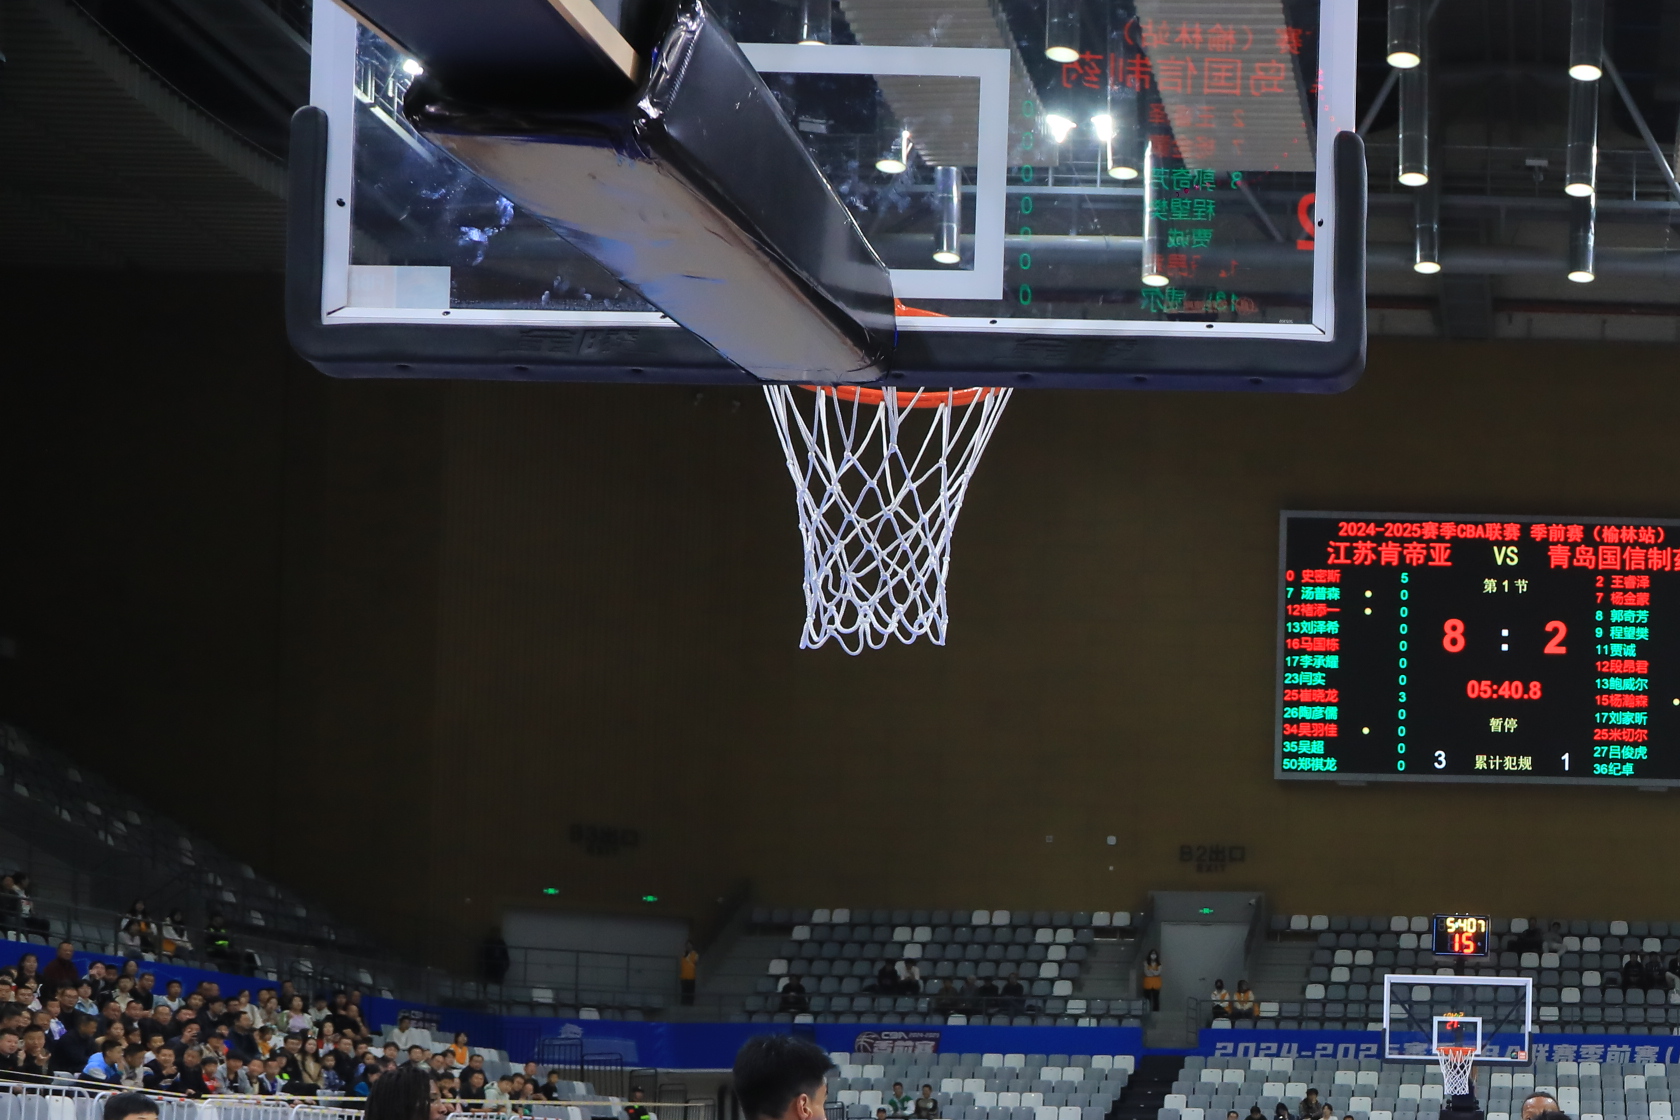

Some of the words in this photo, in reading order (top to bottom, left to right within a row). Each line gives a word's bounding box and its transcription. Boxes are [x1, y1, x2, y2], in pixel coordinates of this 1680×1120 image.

[1338, 522, 1521, 541] 2024-2025赛季CBA联赛
[1327, 540, 1452, 566] 江苏肯帝亚
[1493, 546, 1518, 565] VS
[1285, 570, 1295, 581] 0
[1301, 569, 1341, 583] 史密斯
[1401, 573, 1408, 583] 5
[1596, 576, 1604, 587] 2
[1483, 578, 1497, 593] 第
[1503, 580, 1508, 592] 1
[1515, 579, 1528, 593] 节
[1286, 588, 1294, 598] 7
[1301, 586, 1340, 600] 汤普森
[1400, 590, 1408, 600] 0
[1596, 592, 1604, 603] 7
[1400, 607, 1408, 617] 0
[1595, 610, 1603, 621] 8
[1400, 624, 1407, 634] 0
[1595, 627, 1603, 638] 9
[1442, 619, 1466, 653] 8
[1544, 620, 1567, 654] 2
[1286, 637, 1340, 651] 16马国栋
[1399, 641, 1407, 651] 0
[1596, 643, 1636, 657] 11贾诚
[1399, 658, 1407, 668] 0
[1399, 675, 1406, 685] 0
[1399, 692, 1406, 702] 3
[1467, 680, 1542, 700] 05:40.8
[1398, 709, 1406, 719] 0
[1398, 726, 1406, 736] 0
[1490, 718, 1517, 732] 暂停
[1283, 740, 1324, 754] 35吴超
[1398, 743, 1405, 753] 0
[1397, 760, 1405, 771] 0
[1434, 751, 1446, 769] 3
[1475, 755, 1532, 770] 累计犯规
[1561, 753, 1569, 771] 1
[1454, 932, 1476, 954] 15
